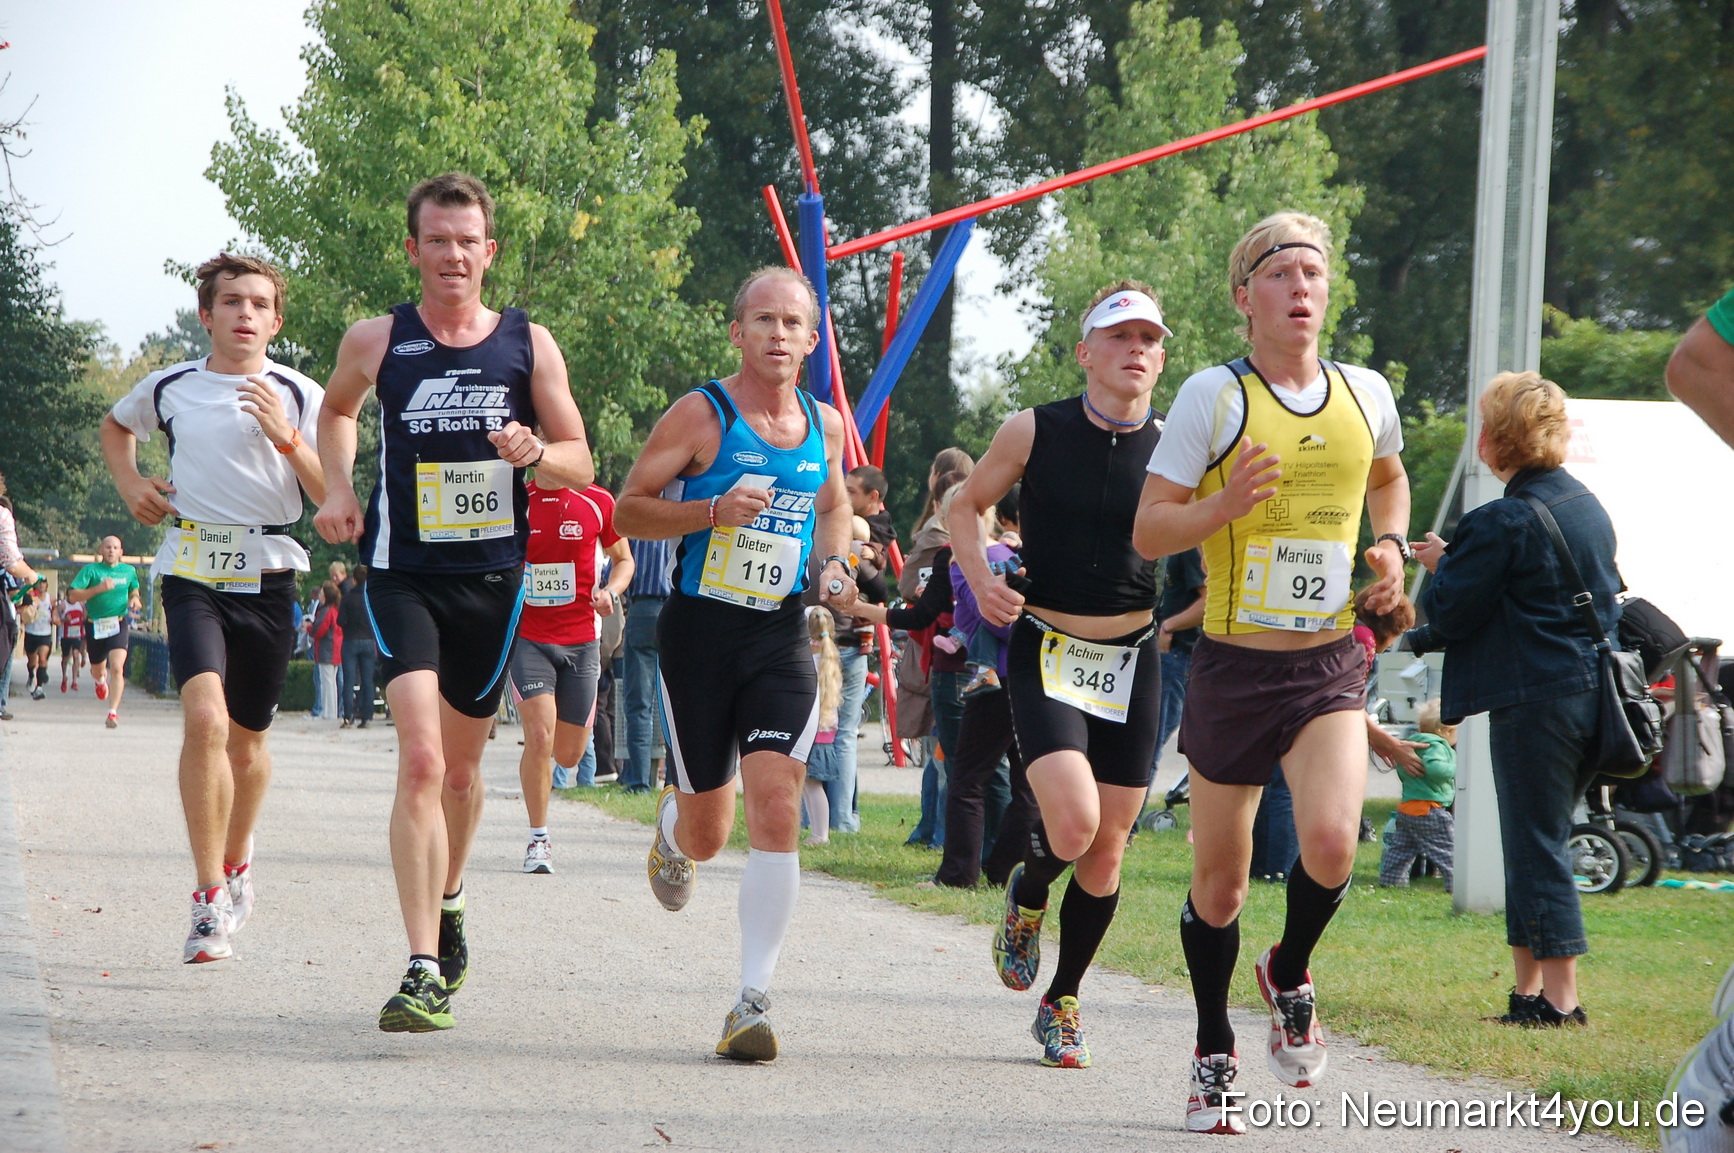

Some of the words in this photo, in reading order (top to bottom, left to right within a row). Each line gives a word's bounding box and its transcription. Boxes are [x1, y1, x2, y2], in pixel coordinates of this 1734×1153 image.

[425, 392, 506, 409] NAGEL
[409, 420, 432, 434] SC
[438, 417, 480, 432] Roth
[485, 416, 503, 430] 52
[444, 469, 485, 484] Martin
[422, 493, 429, 504] A
[454, 490, 499, 515] 966
[200, 528, 232, 544] Daniel
[480, 524, 513, 534] PFLEIDERER
[736, 533, 773, 554] Dieter
[182, 546, 188, 556] A
[208, 551, 247, 570] 173
[1276, 545, 1324, 565] Marius
[534, 567, 559, 577] Patrick
[710, 550, 717, 561] A
[742, 560, 782, 586] 119
[226, 581, 259, 589] PFLEIDERER
[536, 579, 570, 592] 3435
[1246, 569, 1254, 582] A
[1291, 575, 1327, 601] 92
[1066, 643, 1105, 662] Achim
[522, 681, 544, 692] ODLO
[1072, 667, 1116, 694] 348
[758, 730, 792, 741] asics
